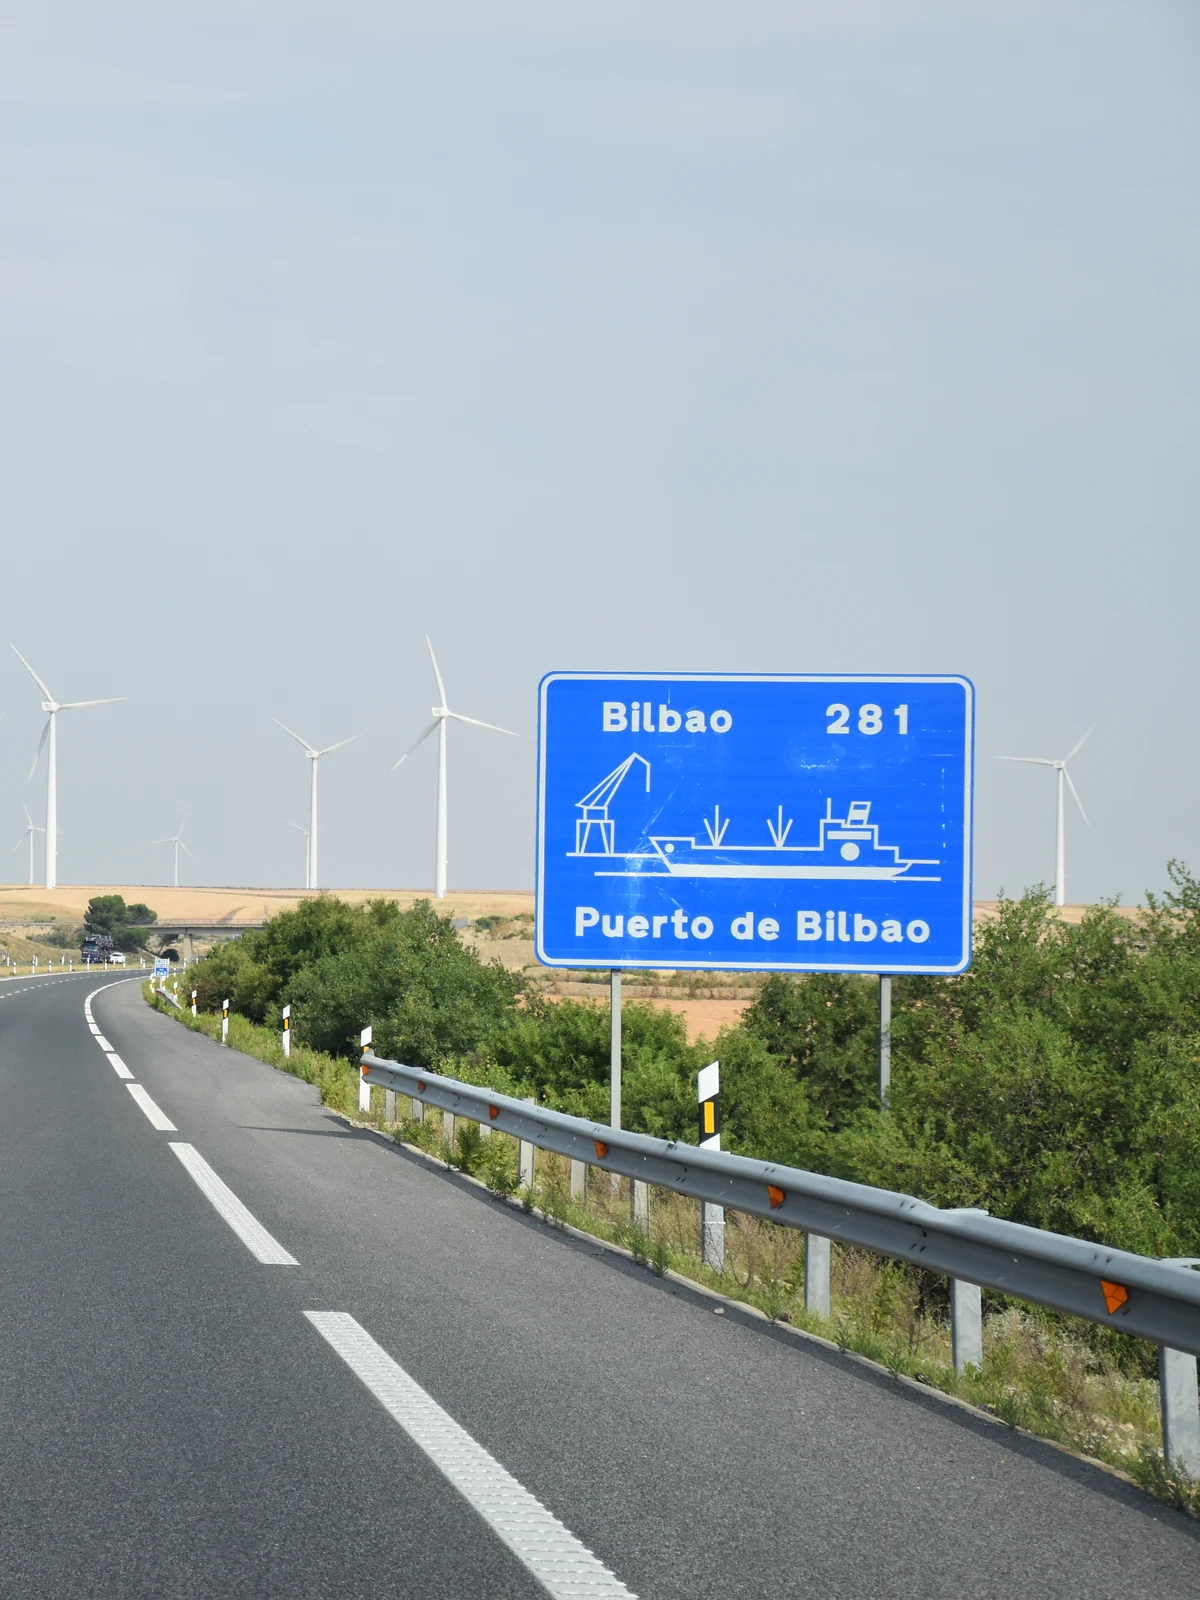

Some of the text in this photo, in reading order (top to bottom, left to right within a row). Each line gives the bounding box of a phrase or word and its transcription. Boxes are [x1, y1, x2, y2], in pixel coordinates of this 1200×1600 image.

[602, 701, 909, 735] Bilbao 281
[575, 906, 930, 943] Puerto de Bilbao
